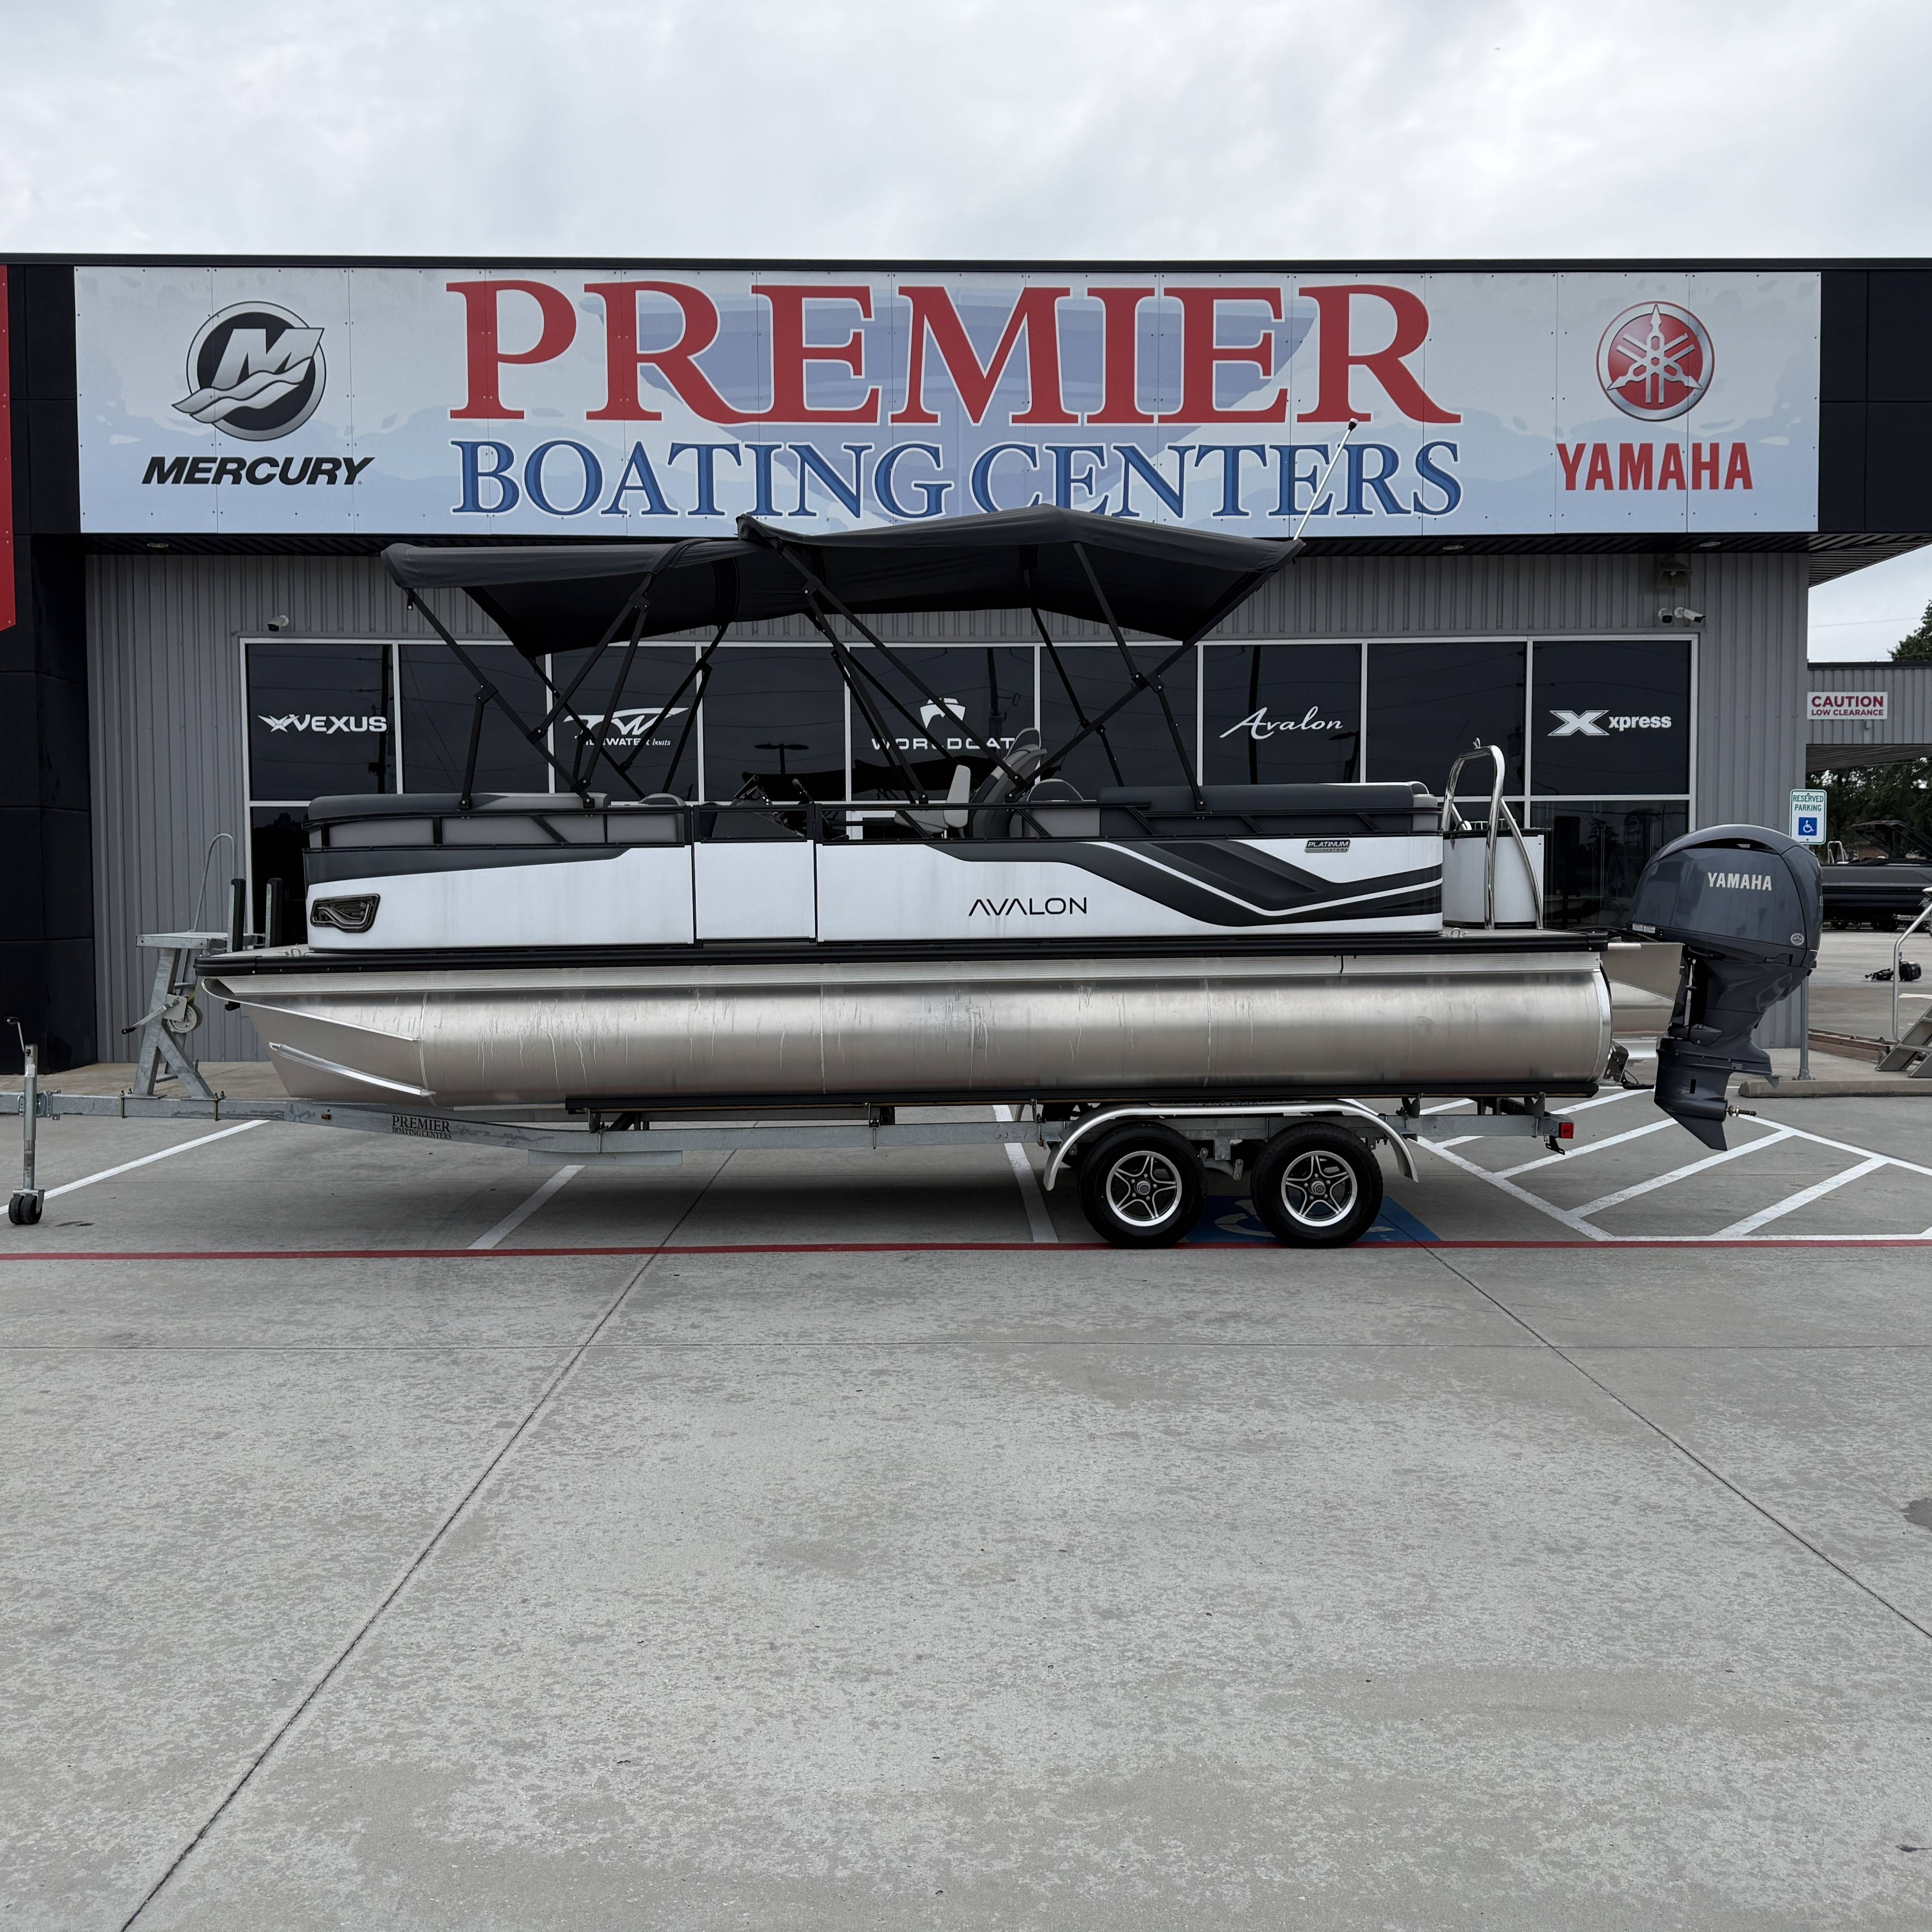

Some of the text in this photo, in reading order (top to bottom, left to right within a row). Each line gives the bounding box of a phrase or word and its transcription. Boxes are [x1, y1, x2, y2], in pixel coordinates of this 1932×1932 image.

[446, 280, 1461, 425] PREMIER
[141, 456, 375, 486] MERCURY
[1556, 442, 1754, 491] YAMAHA
[451, 439, 1461, 519] BOATING CENTERS
[1811, 695, 1884, 708] CAUTION
[289, 714, 387, 734] VEXUS
[1219, 705, 1343, 740] Avalon
[1608, 715, 1672, 731] xpress
[652, 738, 671, 746] boats
[871, 737, 1015, 750] WORDCAT
[1707, 872, 1772, 891] YAMAHA
[968, 897, 1087, 916] AVALON
[392, 1115, 451, 1133] PREMIER
[392, 1127, 452, 1140] BOATING CENTERS
